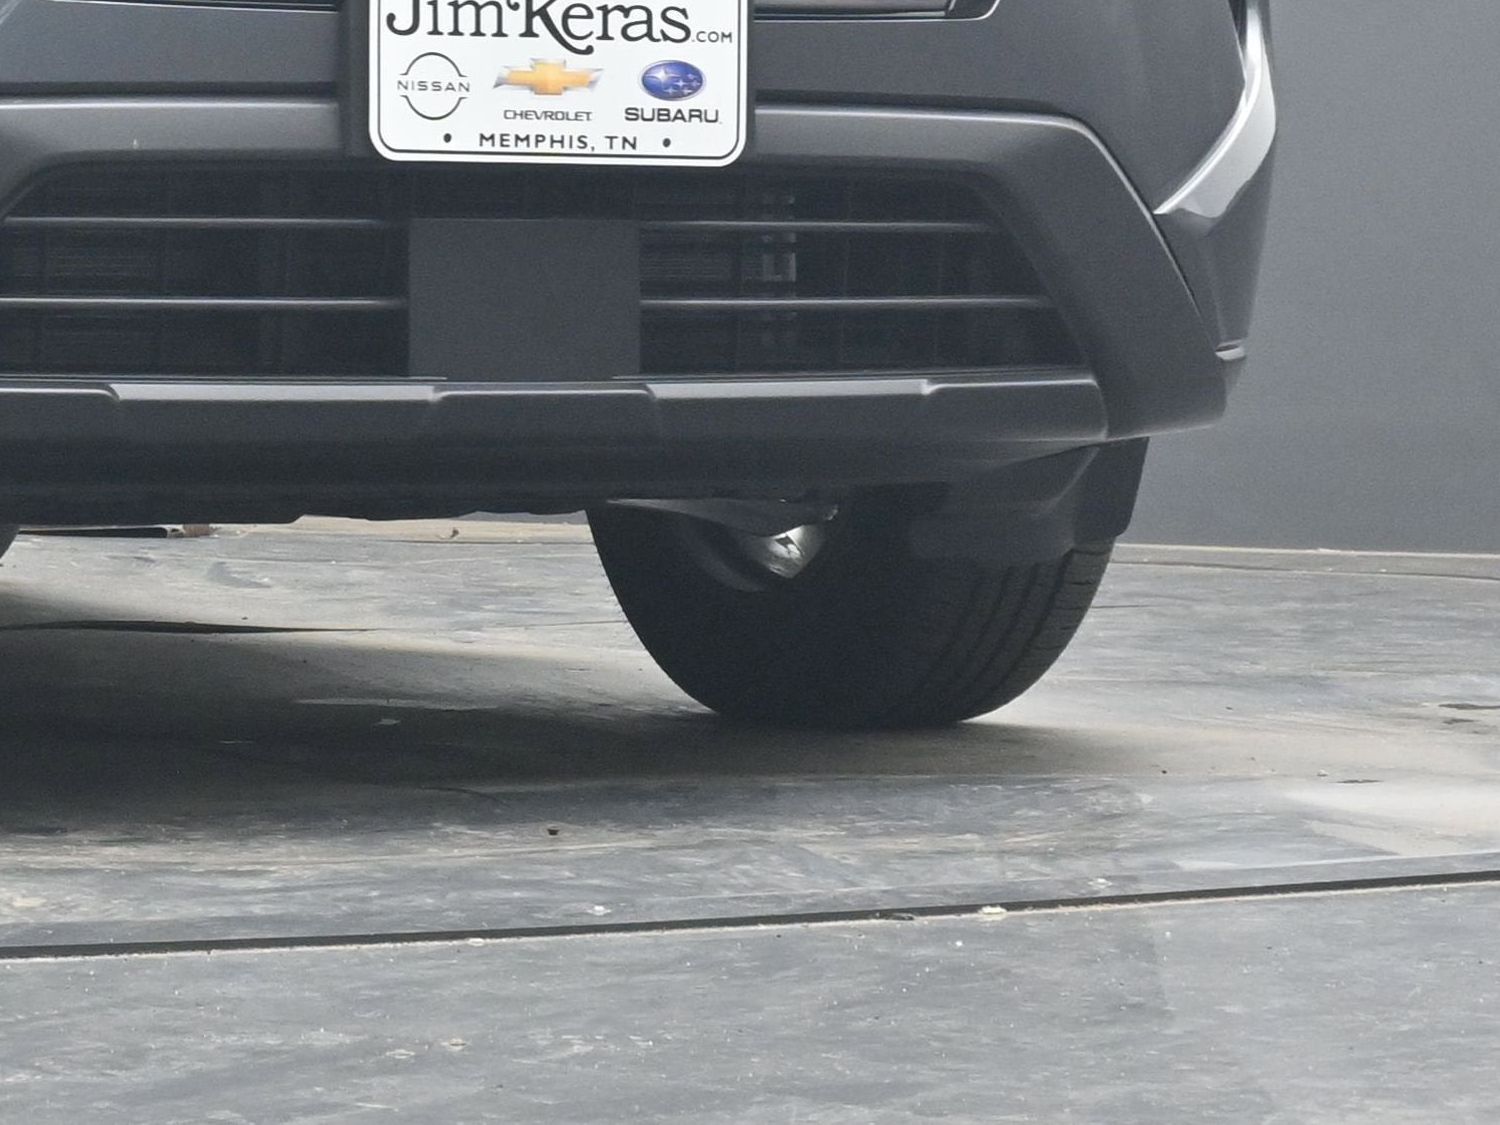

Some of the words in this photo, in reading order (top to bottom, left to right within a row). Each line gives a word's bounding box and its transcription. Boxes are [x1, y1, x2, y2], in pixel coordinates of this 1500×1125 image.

[397, 79, 470, 93] NISSAN
[504, 110, 591, 121] CHEVROLET
[625, 107, 718, 123] SUBARU
[479, 132, 596, 152] MEMPHIS,
[605, 135, 638, 150] TN
